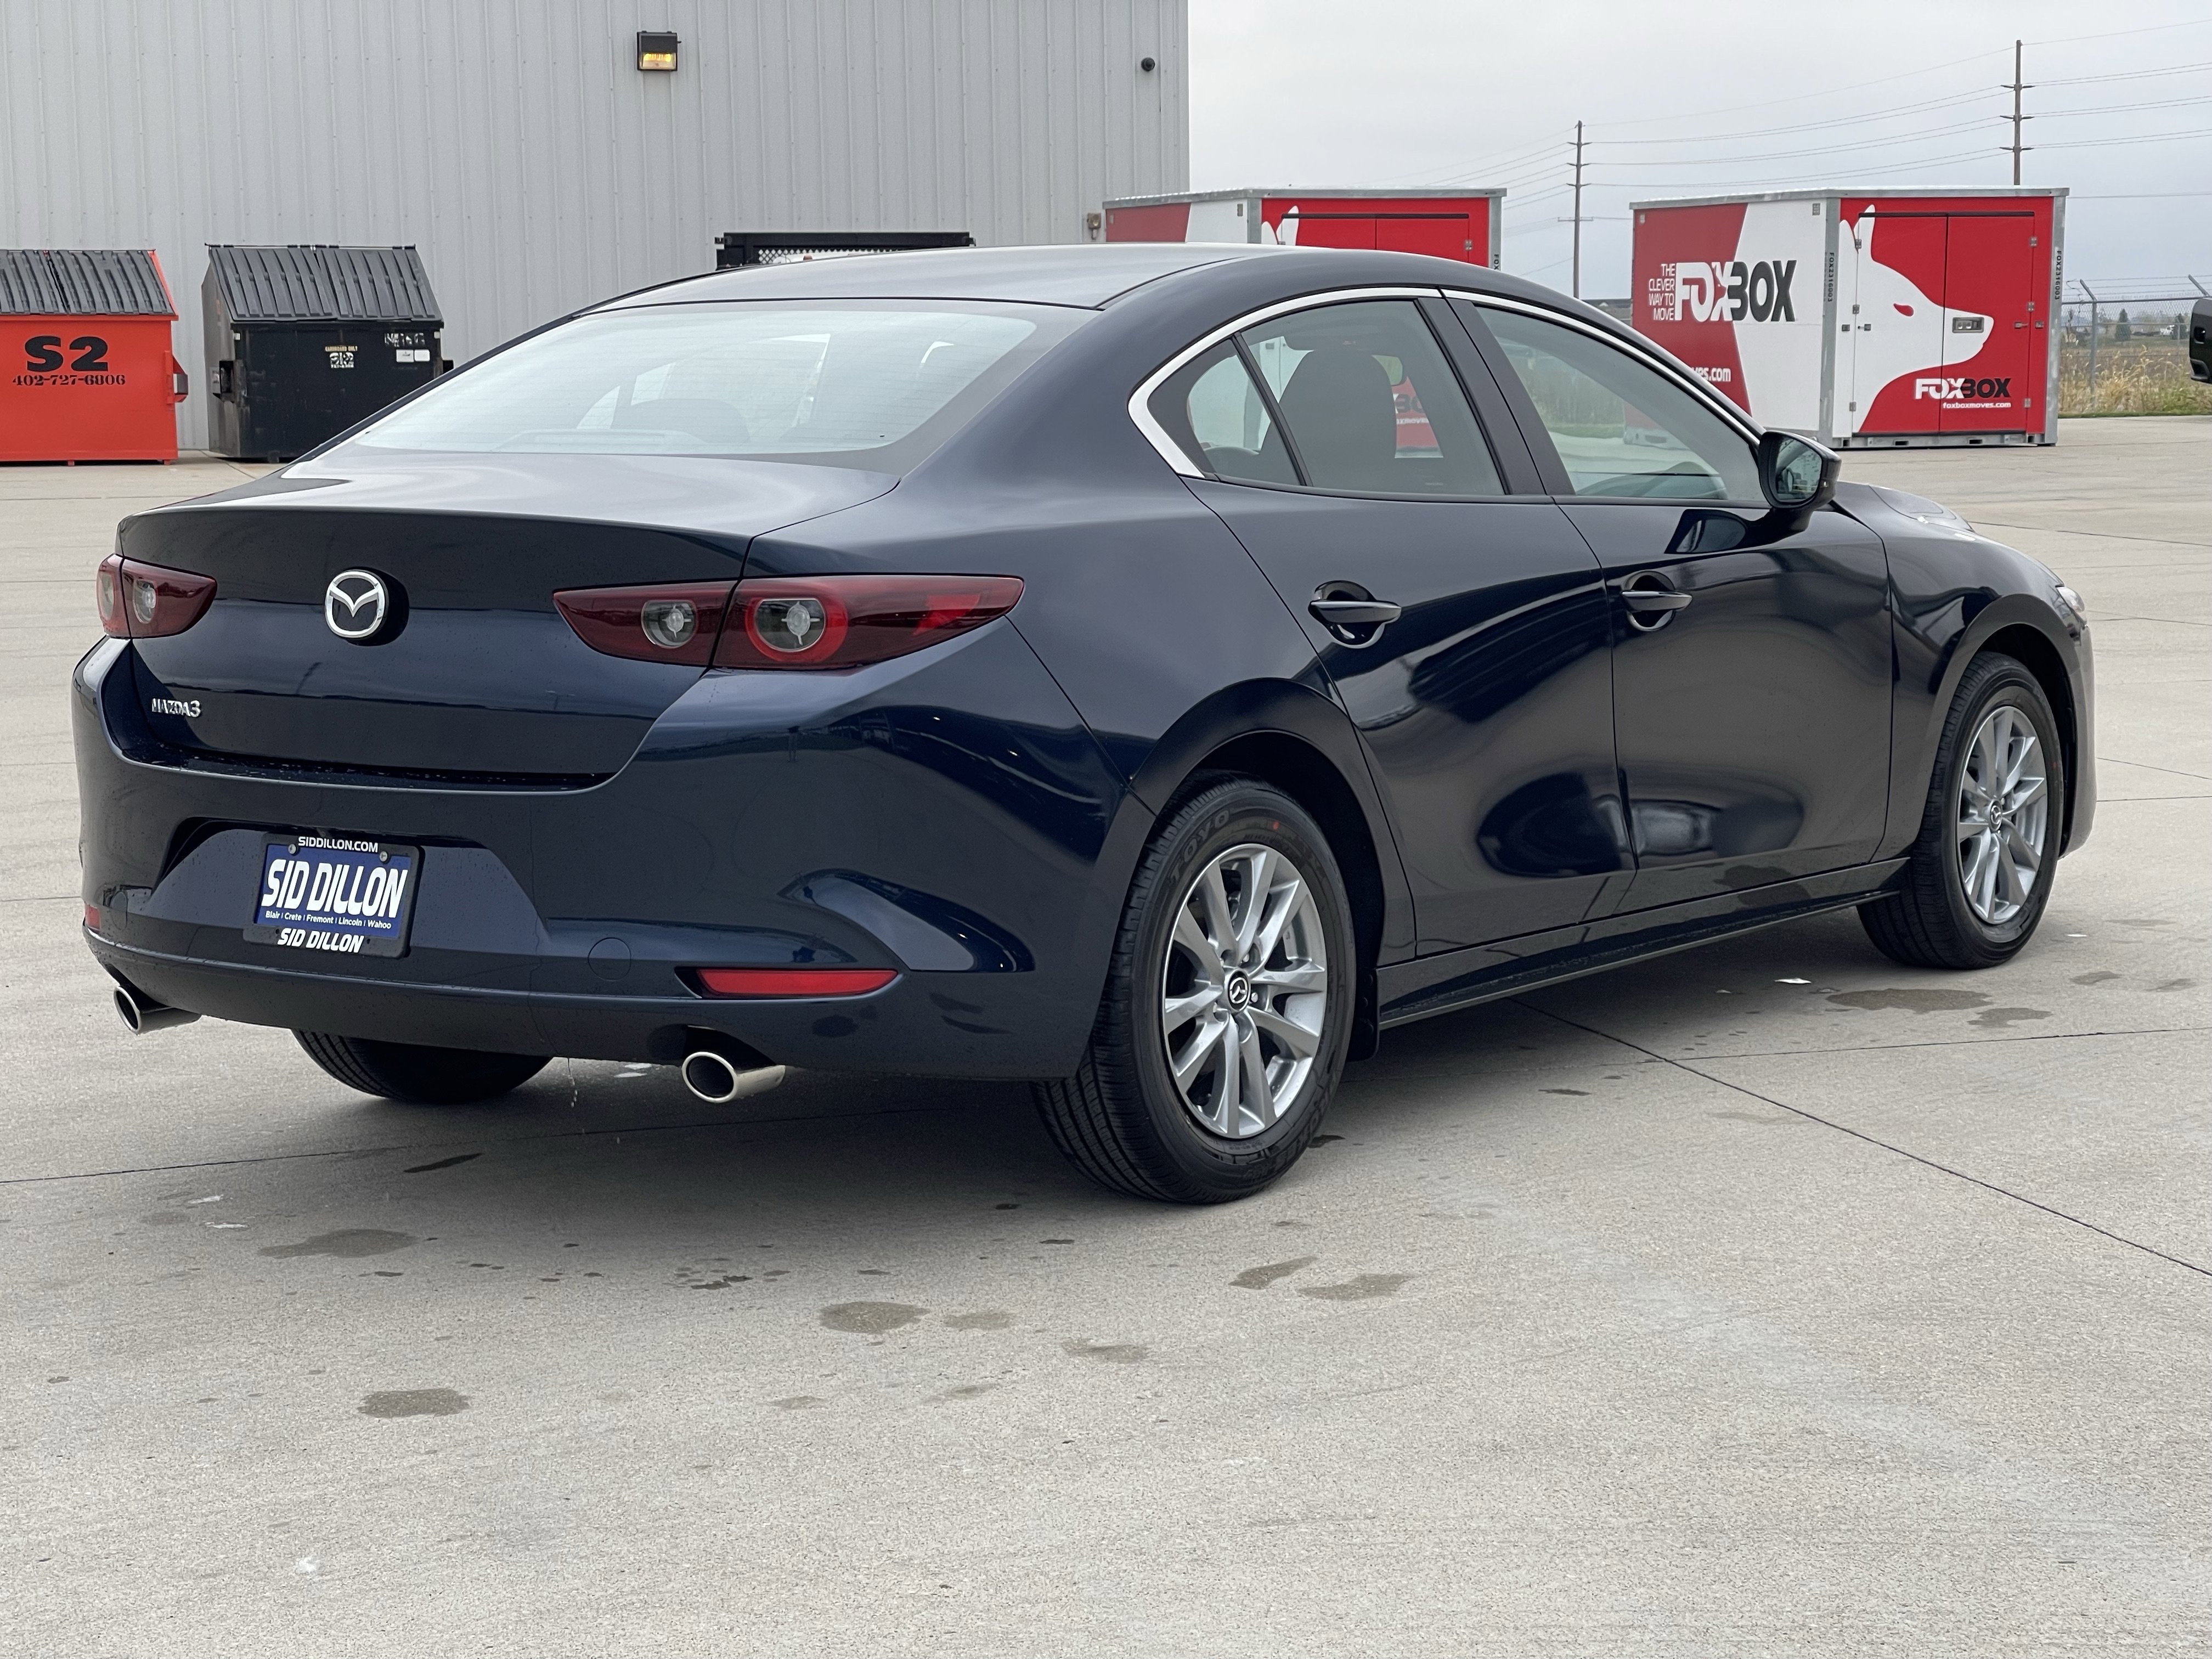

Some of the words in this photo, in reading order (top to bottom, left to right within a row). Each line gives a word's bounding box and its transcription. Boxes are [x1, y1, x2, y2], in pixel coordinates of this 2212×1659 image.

[1661, 263, 1675, 276] THE
[1649, 278, 1675, 291] CLEVER
[1675, 259, 1797, 323] FOXBOX
[1649, 293, 1664, 306] WAY
[1664, 293, 1674, 306] TO
[1654, 307, 1674, 320] MOVE
[25, 335, 109, 373] S2
[12, 374, 126, 386] 402-727-6806
[1915, 377, 2011, 399] FOXBOX
[151, 698, 201, 718] MAZDA3
[298, 836, 379, 853] SIDDILLON.COM
[261, 859, 310, 910] SID
[306, 862, 408, 918] DILLON
[266, 910, 280, 919] Blair
[284, 912, 302, 921] Crete
[306, 914, 334, 924] Fremont
[338, 917, 363, 927] Lincoln
[367, 919, 392, 929] Wahoo
[277, 928, 306, 947] SID
[306, 930, 364, 953] DILLON
